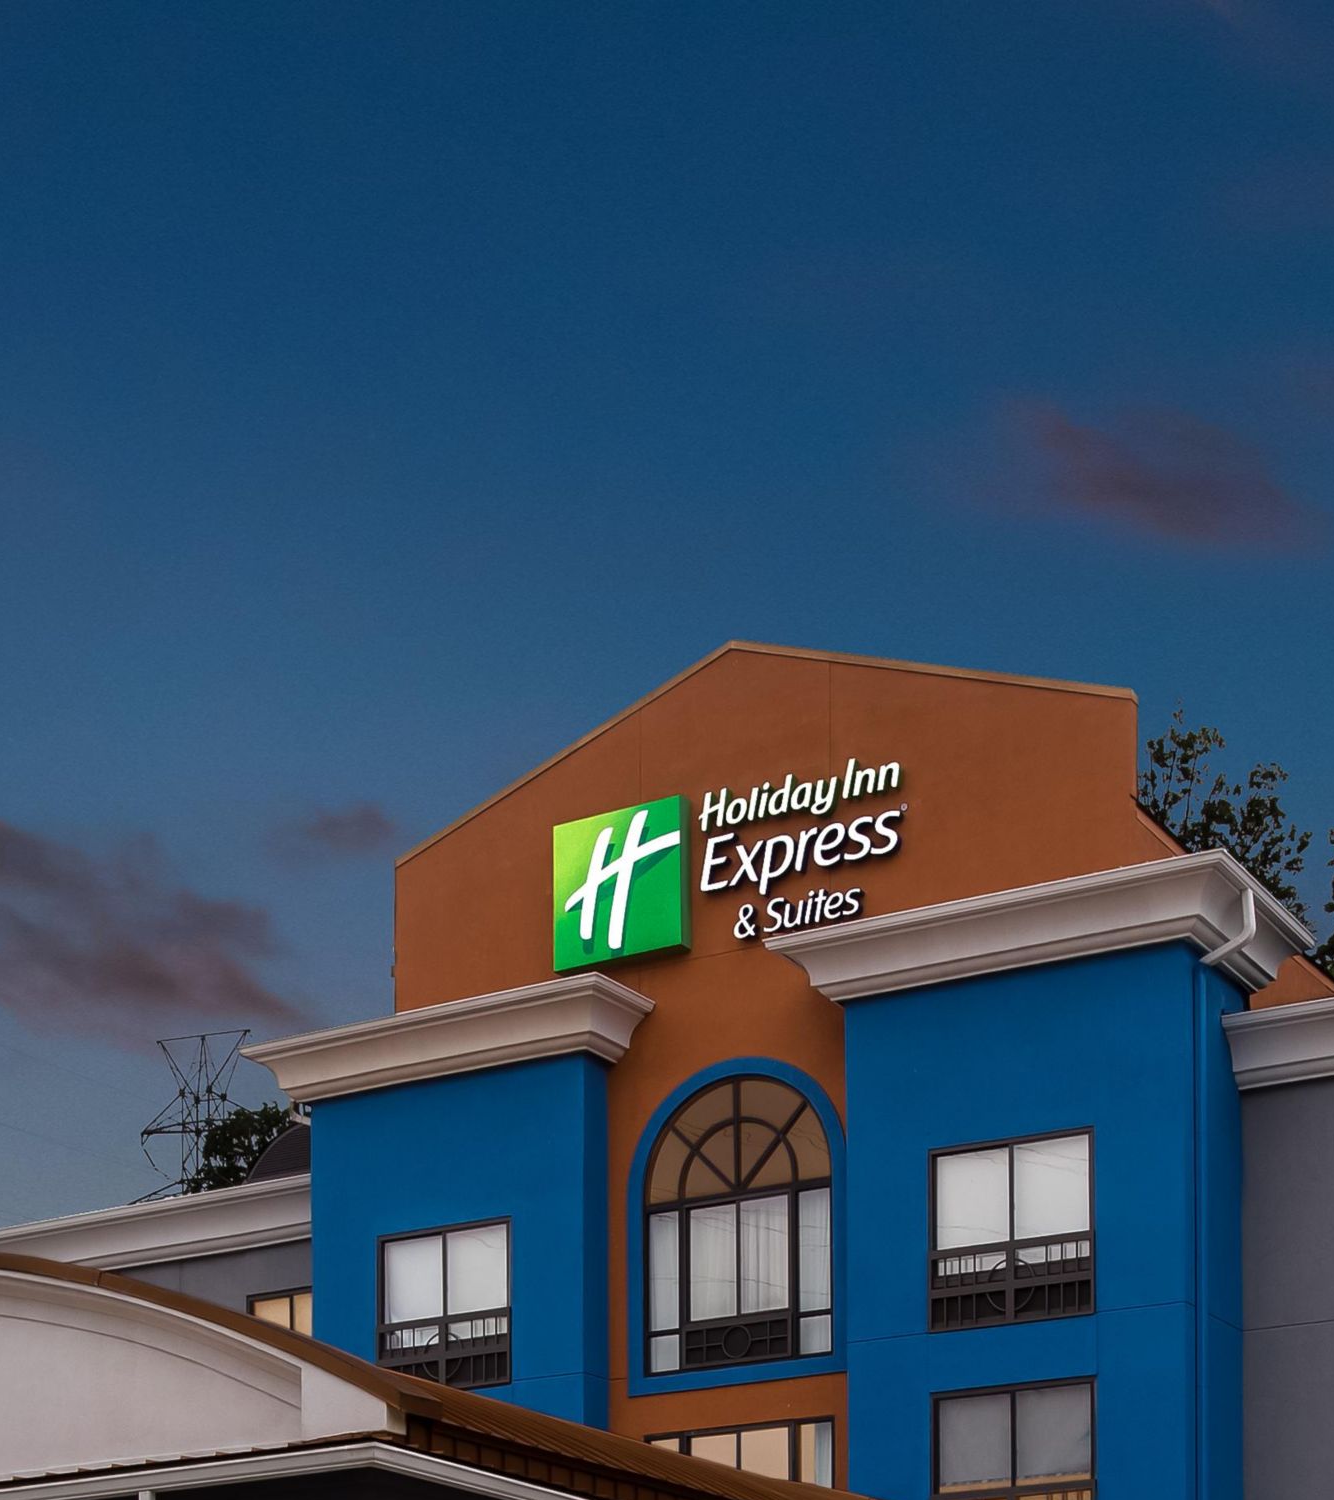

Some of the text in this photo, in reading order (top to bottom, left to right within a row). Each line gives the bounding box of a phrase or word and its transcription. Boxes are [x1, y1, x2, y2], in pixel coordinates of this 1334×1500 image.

[698, 758, 900, 832] Holiday Inn
[700, 810, 901, 896] Express
[733, 888, 861, 939] & Suites
